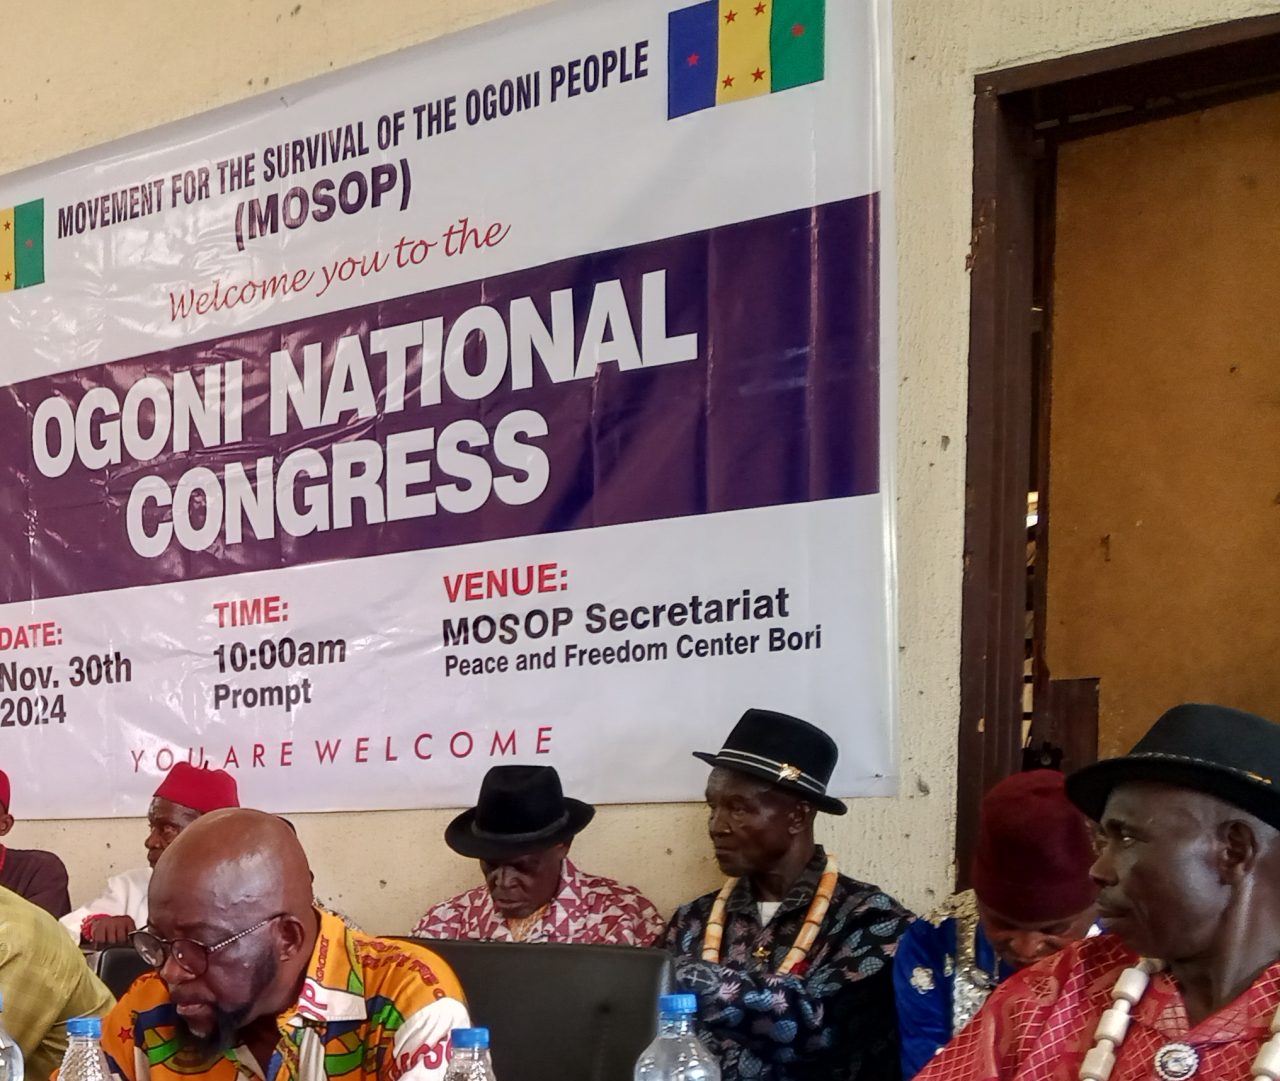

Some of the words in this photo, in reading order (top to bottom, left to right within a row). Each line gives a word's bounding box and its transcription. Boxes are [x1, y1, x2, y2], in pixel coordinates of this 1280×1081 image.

[57, 177, 165, 239] MOVEMENT
[171, 166, 210, 208] FOR
[217, 152, 256, 195] THE
[263, 121, 369, 182] SURVIVAL
[377, 110, 405, 150] OF
[413, 95, 457, 140] THE
[465, 71, 541, 126] OGONI
[550, 40, 649, 103] PEOPLE
[234, 158, 412, 252] (MOSOP)
[169, 269, 316, 323] Welcome
[315, 252, 390, 298] you
[394, 236, 438, 269] to
[442, 217, 512, 257] the
[31, 359, 243, 478] OGONI
[269, 269, 699, 436] NATIONAL
[126, 409, 550, 558] CONGRESS
[443, 562, 569, 603] VENUE:
[213, 595, 289, 629] TIME:
[442, 606, 574, 648] MOSOP
[585, 587, 790, 635] Secretariat
[69, 651, 133, 688] 30th
[213, 637, 347, 674] 10:00am
[445, 652, 509, 677] Peace
[515, 646, 557, 672] and
[564, 637, 668, 668] Freedom
[676, 631, 760, 660] Center
[768, 624, 822, 653] Bori
[0, 693, 67, 727] 2024
[213, 678, 312, 713] Prompt
[223, 741, 293, 769] ARE
[315, 726, 552, 765] WELCOME
